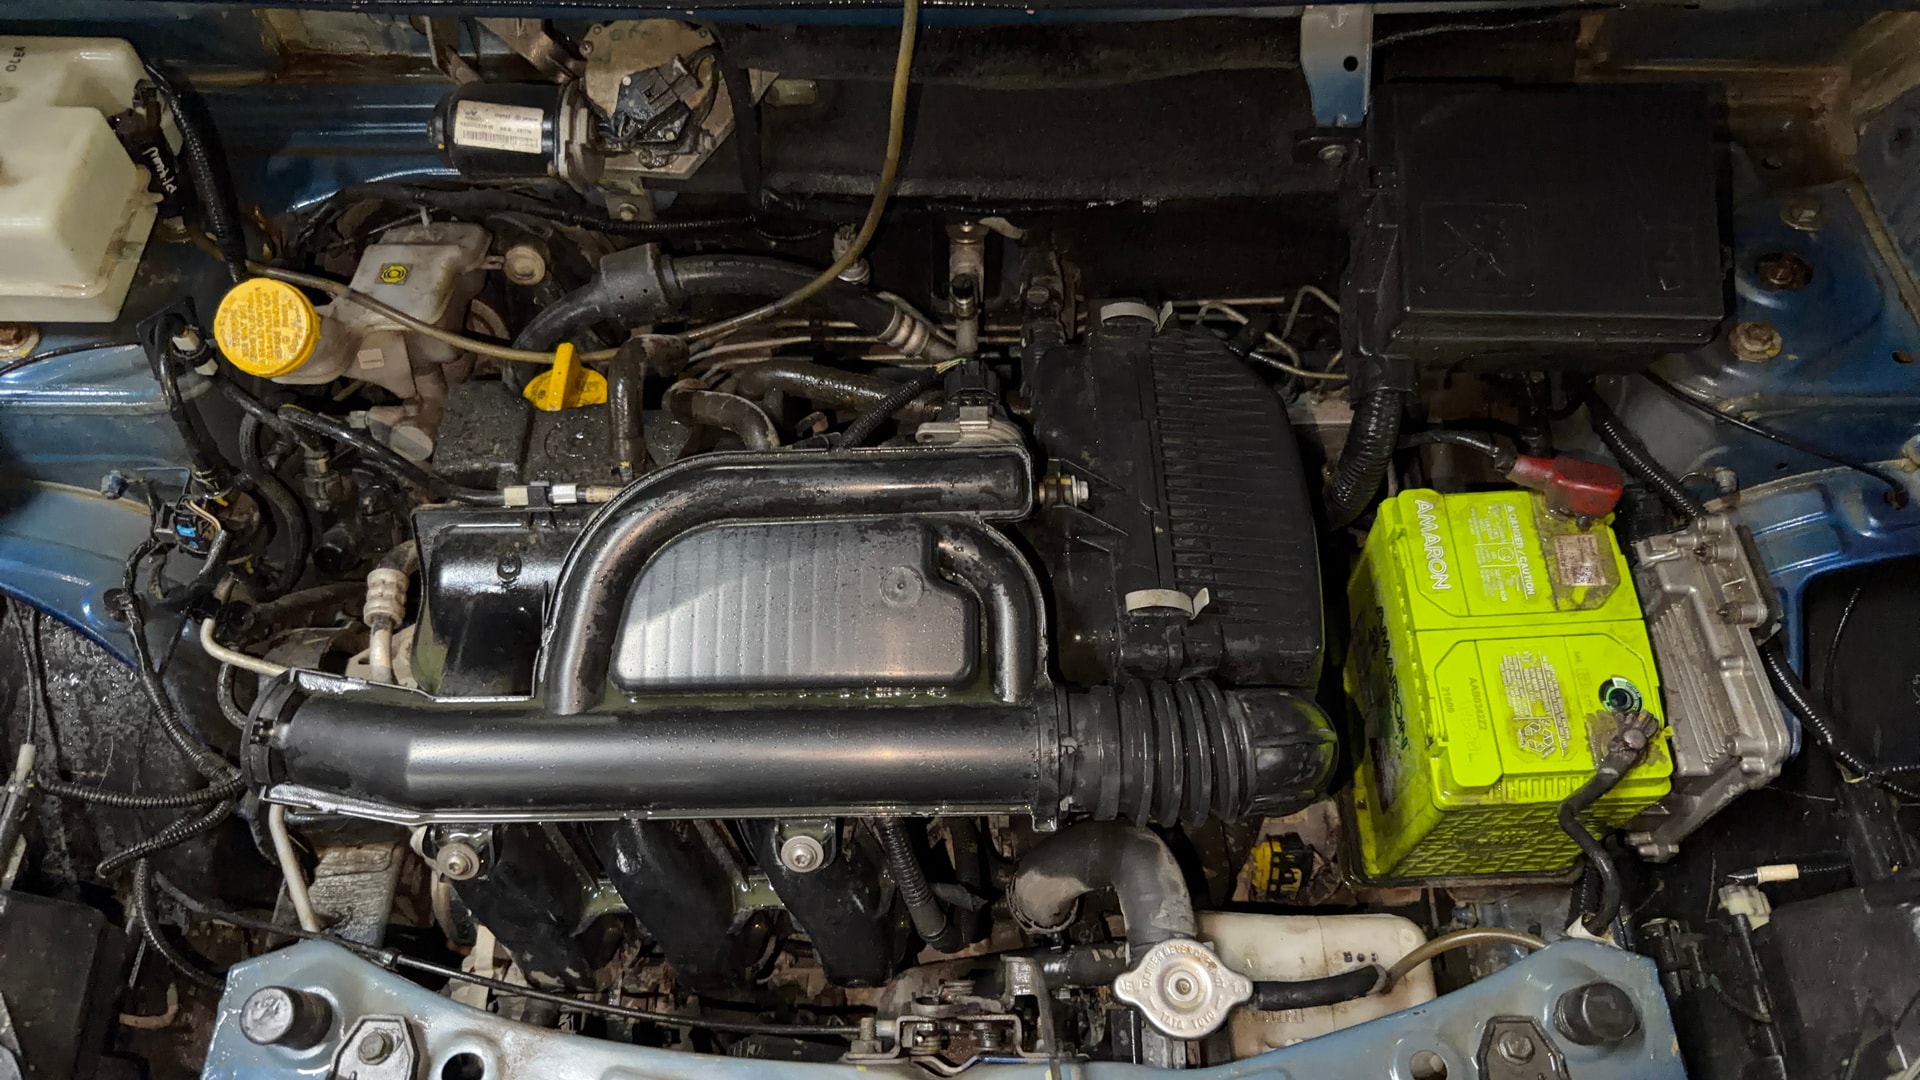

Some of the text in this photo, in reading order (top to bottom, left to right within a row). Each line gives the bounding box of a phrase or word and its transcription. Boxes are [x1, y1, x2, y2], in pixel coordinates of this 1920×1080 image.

[1415, 499, 1451, 590] AMARON
[1508, 513, 1524, 549] DANGER
[1519, 555, 1535, 596] CAUTION
[1160, 1011, 1185, 1031] TATA
